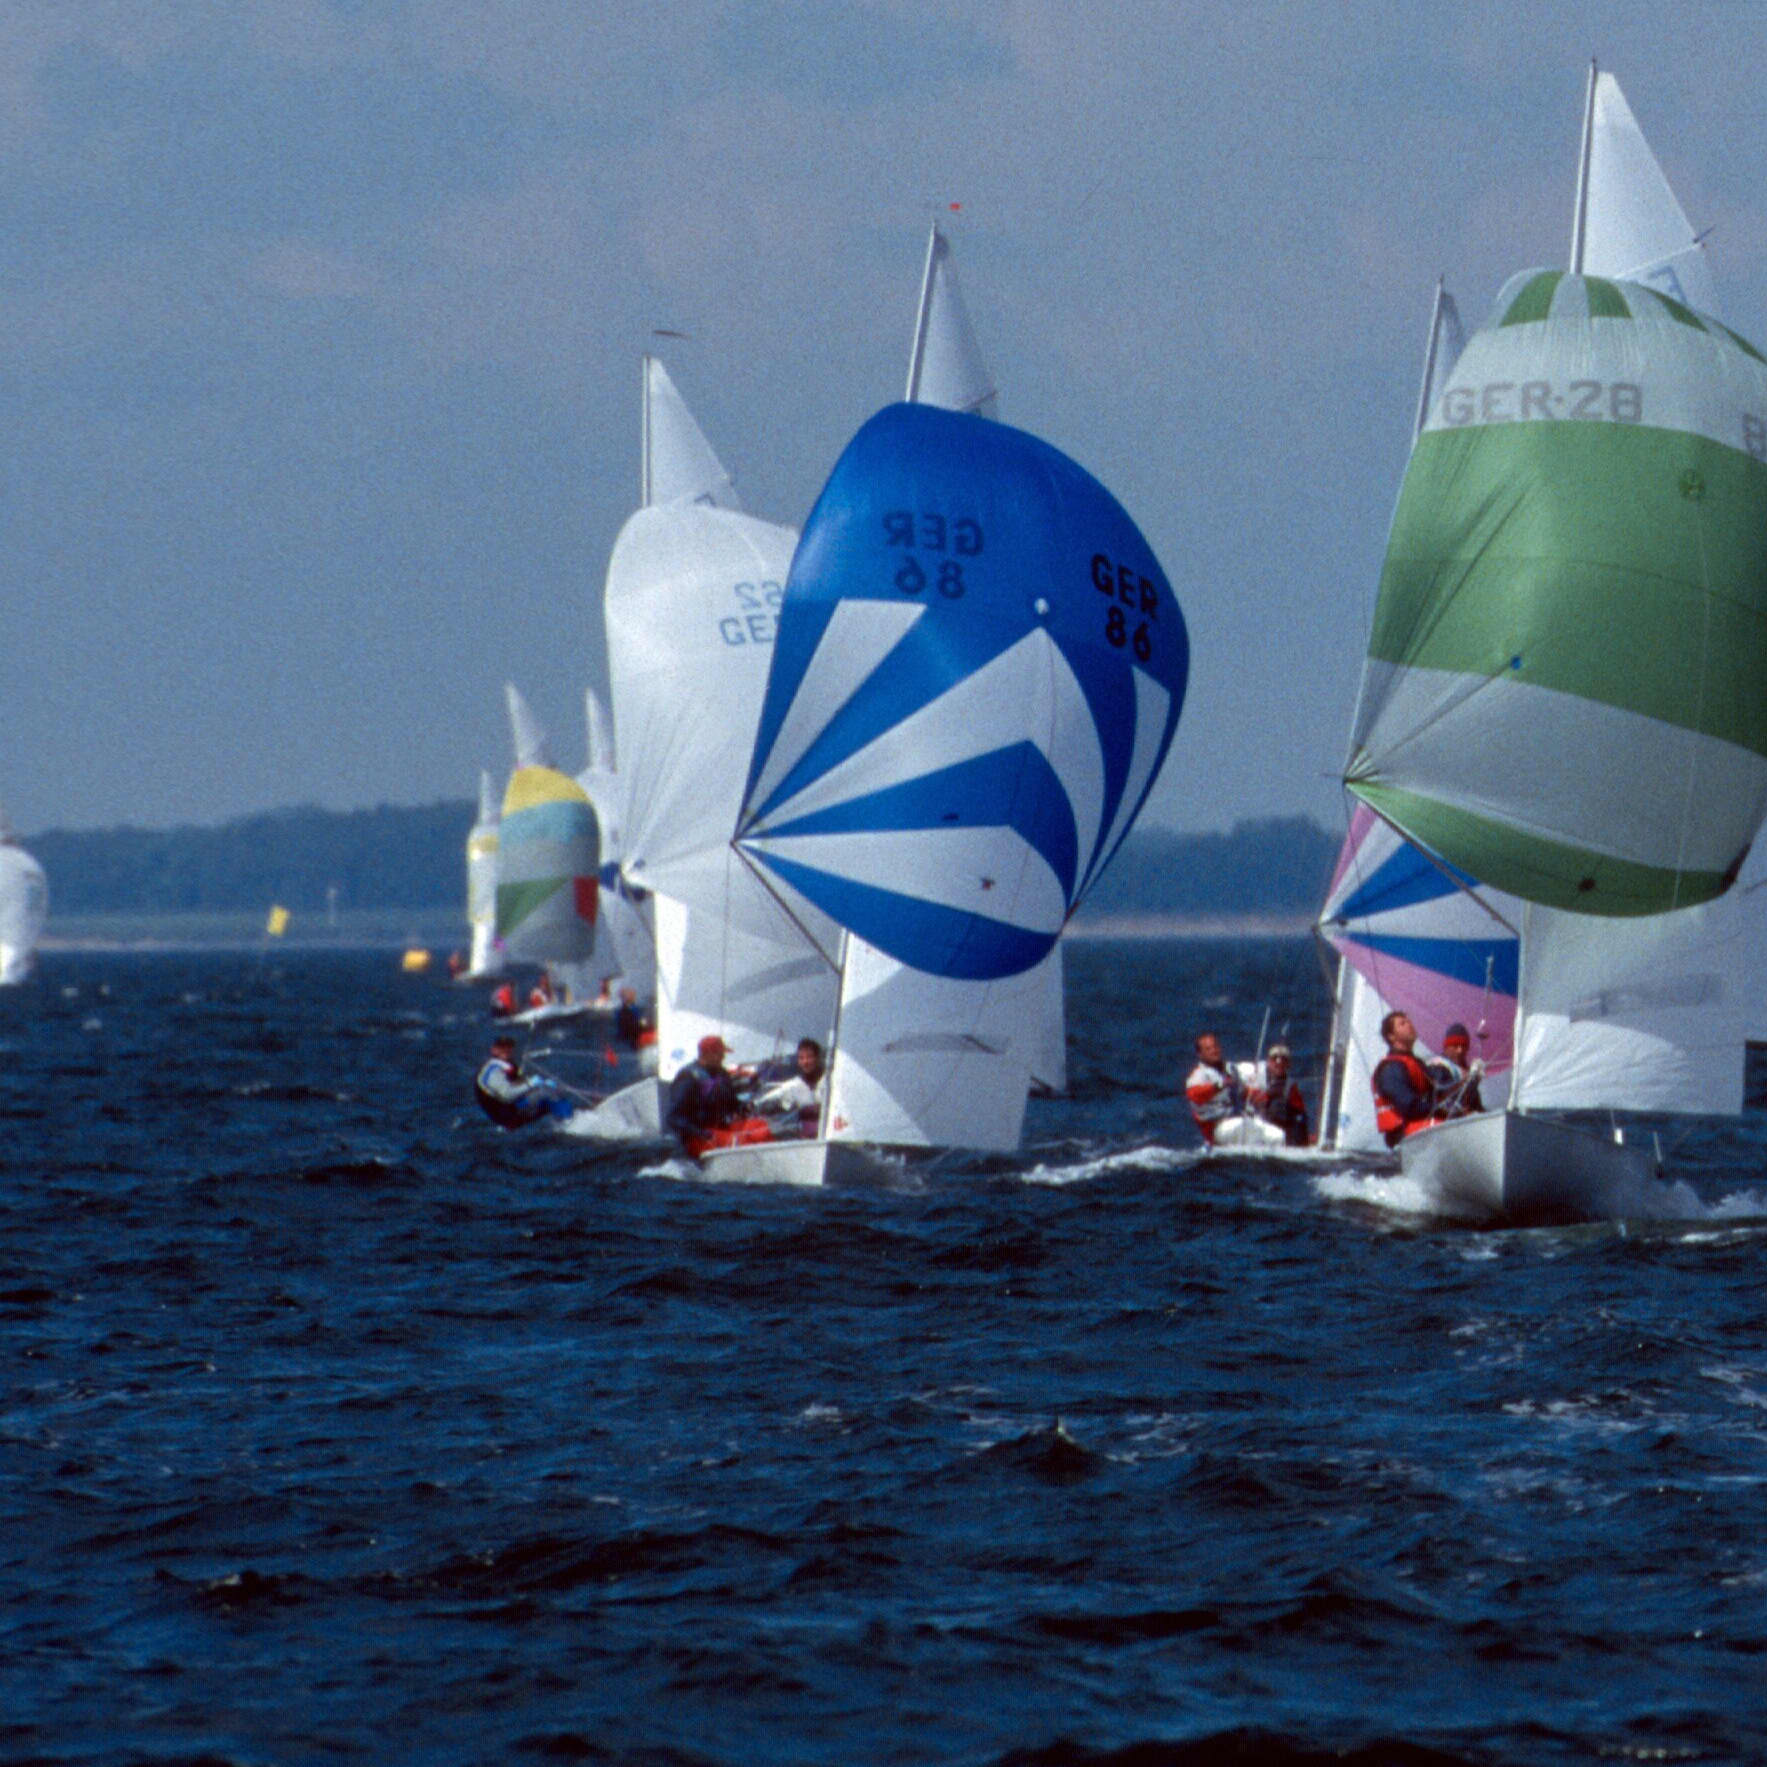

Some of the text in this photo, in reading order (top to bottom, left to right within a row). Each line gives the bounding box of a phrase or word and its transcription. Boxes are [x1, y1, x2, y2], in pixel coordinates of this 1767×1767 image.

[1091, 554, 1159, 621] GER
[719, 613, 781, 646] GE
[1105, 606, 1152, 662] 86
